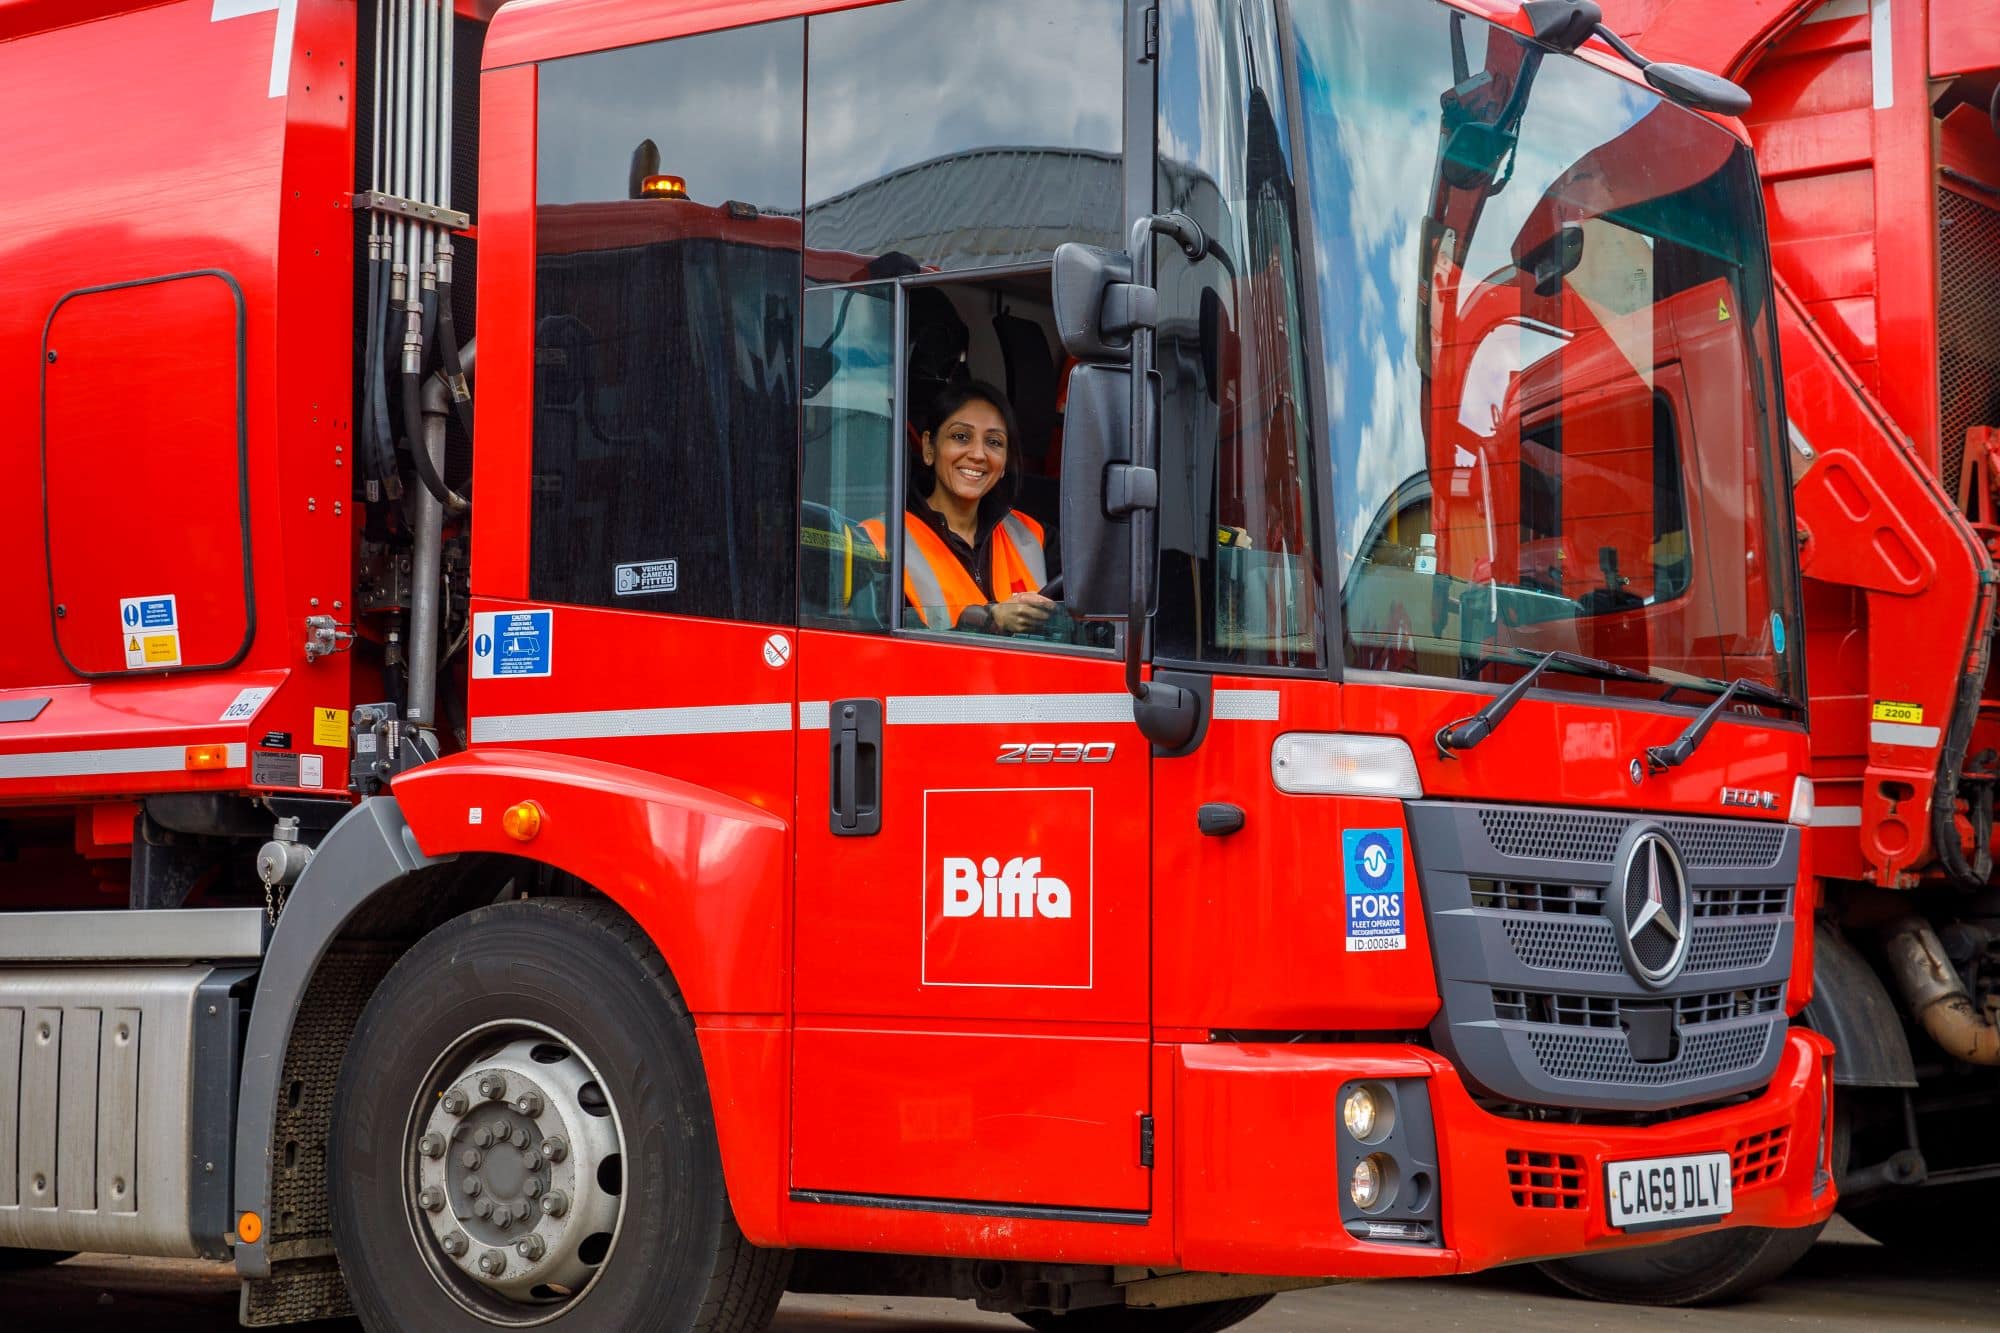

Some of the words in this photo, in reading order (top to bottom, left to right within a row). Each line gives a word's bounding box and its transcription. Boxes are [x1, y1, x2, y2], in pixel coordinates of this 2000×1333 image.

[641, 563, 673, 572] VEHICLE
[641, 570, 673, 579] CAMERA
[641, 577, 673, 586] FITTED
[325, 709, 337, 721] W
[1885, 708, 1911, 719] 2200
[996, 743, 1116, 763] 2630
[1720, 787, 1779, 811] ECONIC
[943, 856, 1071, 918] Biffa
[1351, 894, 1400, 918] FORS
[1352, 920, 1370, 928] FLEET
[1371, 919, 1400, 928] OPERATOR
[1354, 938, 1399, 950] ID:000846
[1619, 1167, 1676, 1215] CA69
[1682, 1162, 1720, 1208] DLV
